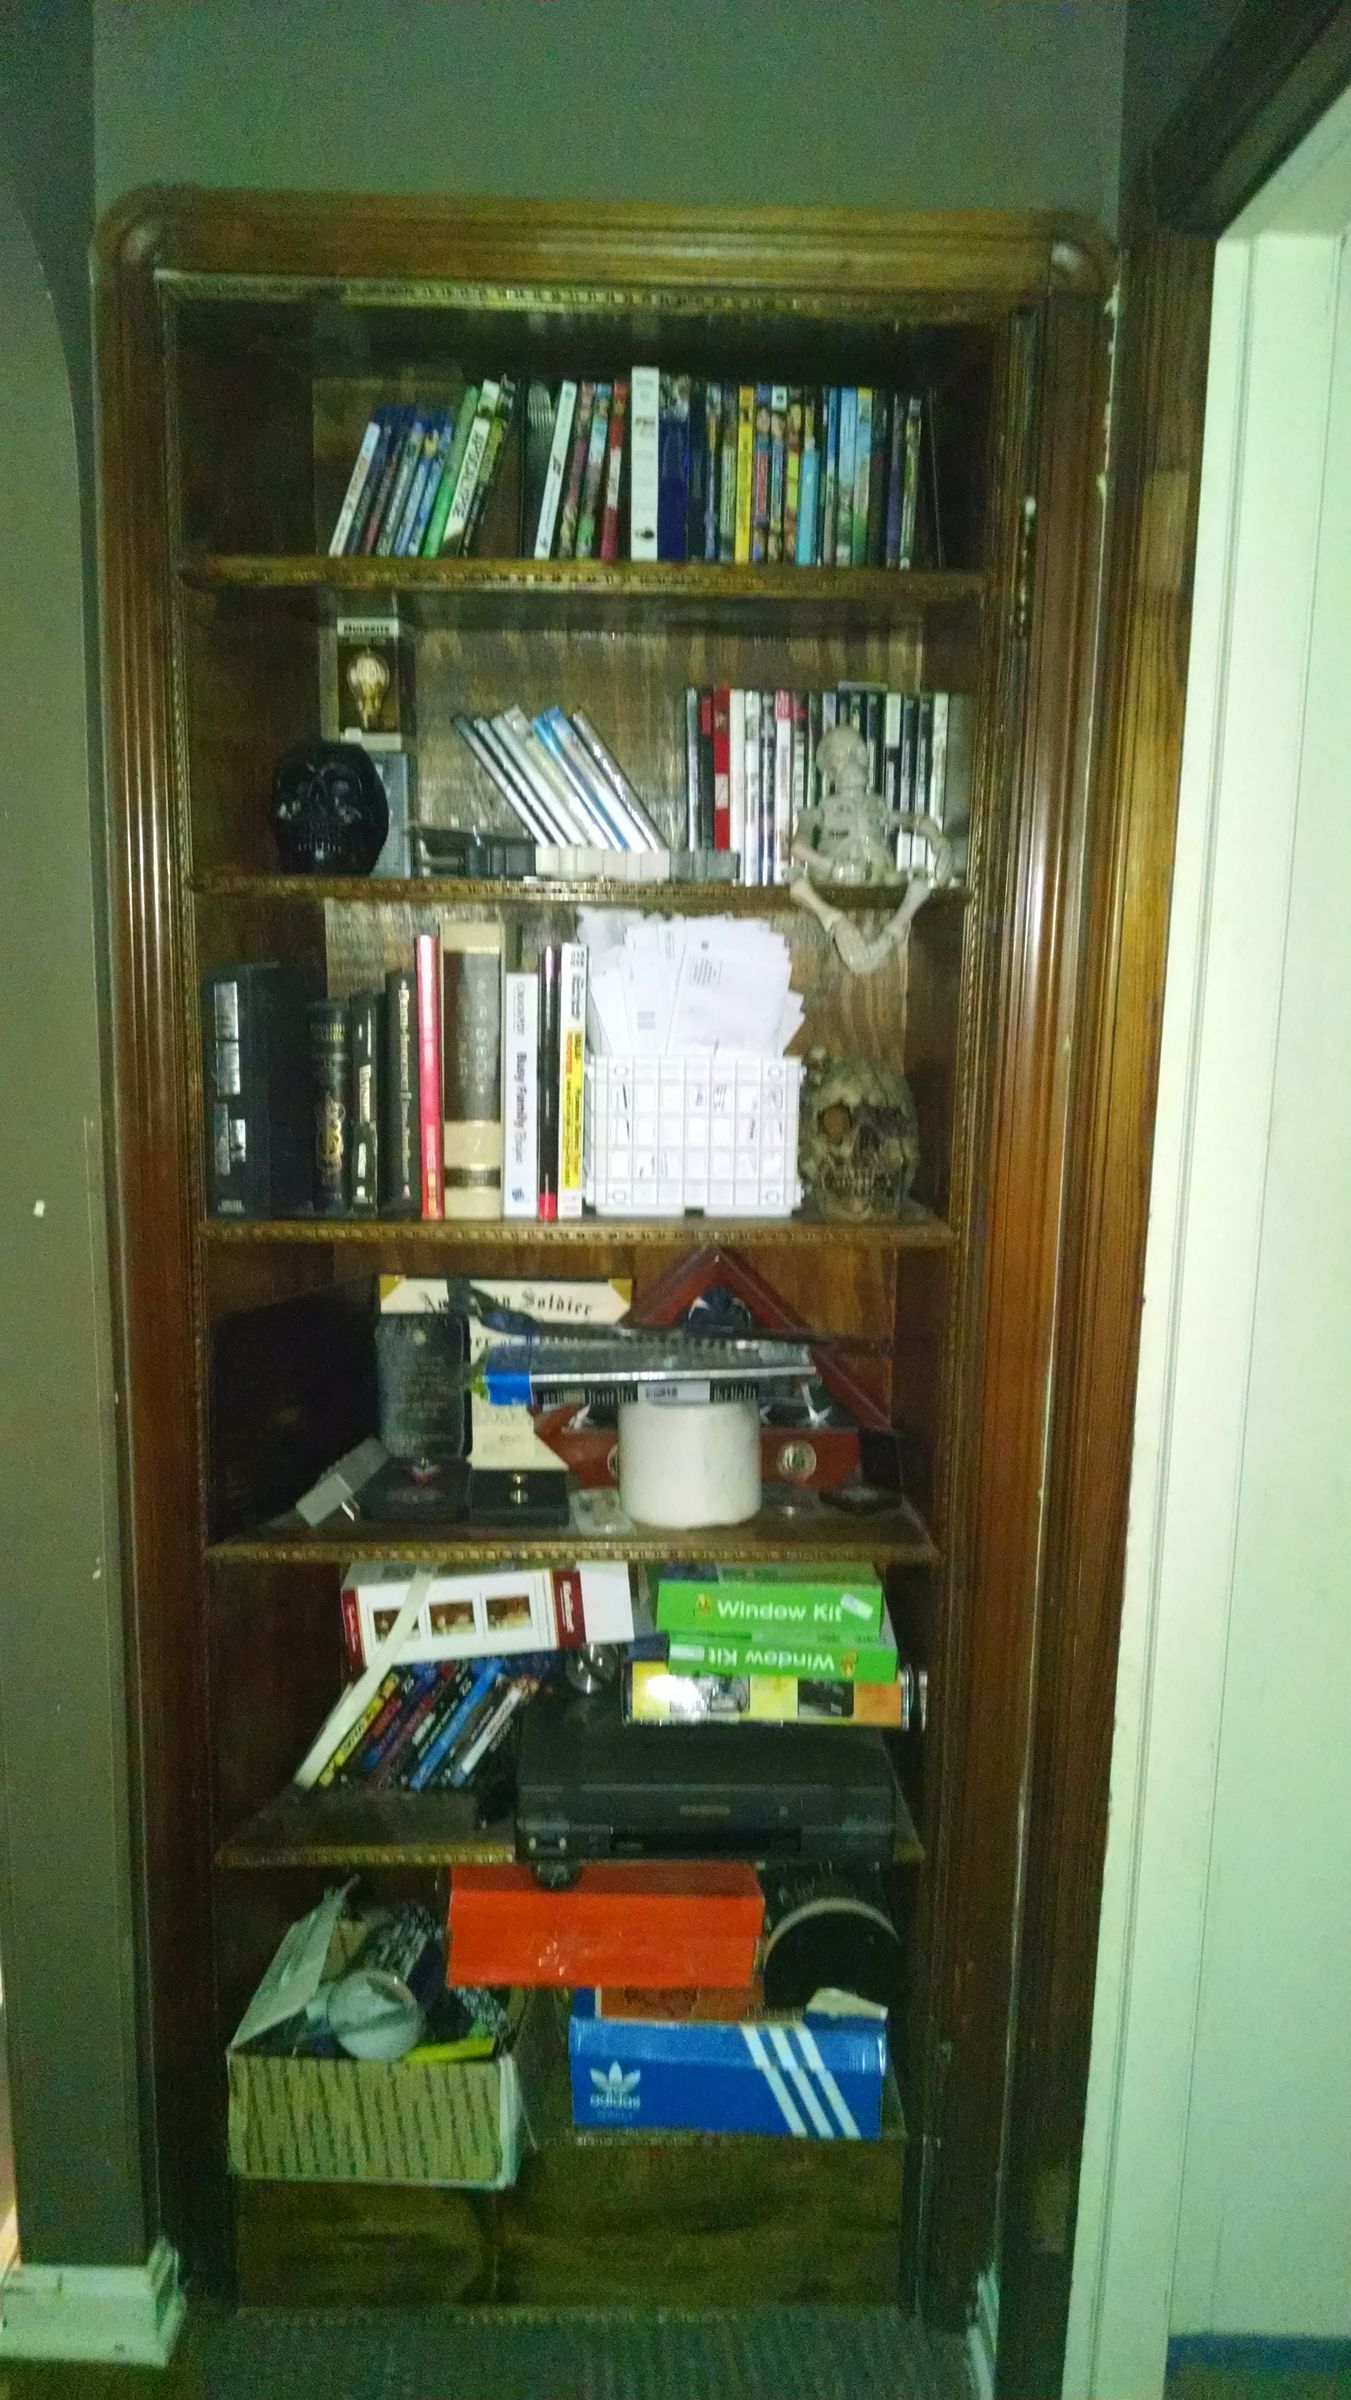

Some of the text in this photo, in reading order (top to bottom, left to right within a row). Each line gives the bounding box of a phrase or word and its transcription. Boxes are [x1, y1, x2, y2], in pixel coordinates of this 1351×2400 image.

[514, 1052, 527, 1082] Busy
[514, 1085, 527, 1128] Family
[521, 1287, 593, 1316] Soldier
[716, 1599, 843, 1623] Window Kit
[707, 1645, 835, 1673] Window Kit
[589, 2091, 640, 2111] adidas
